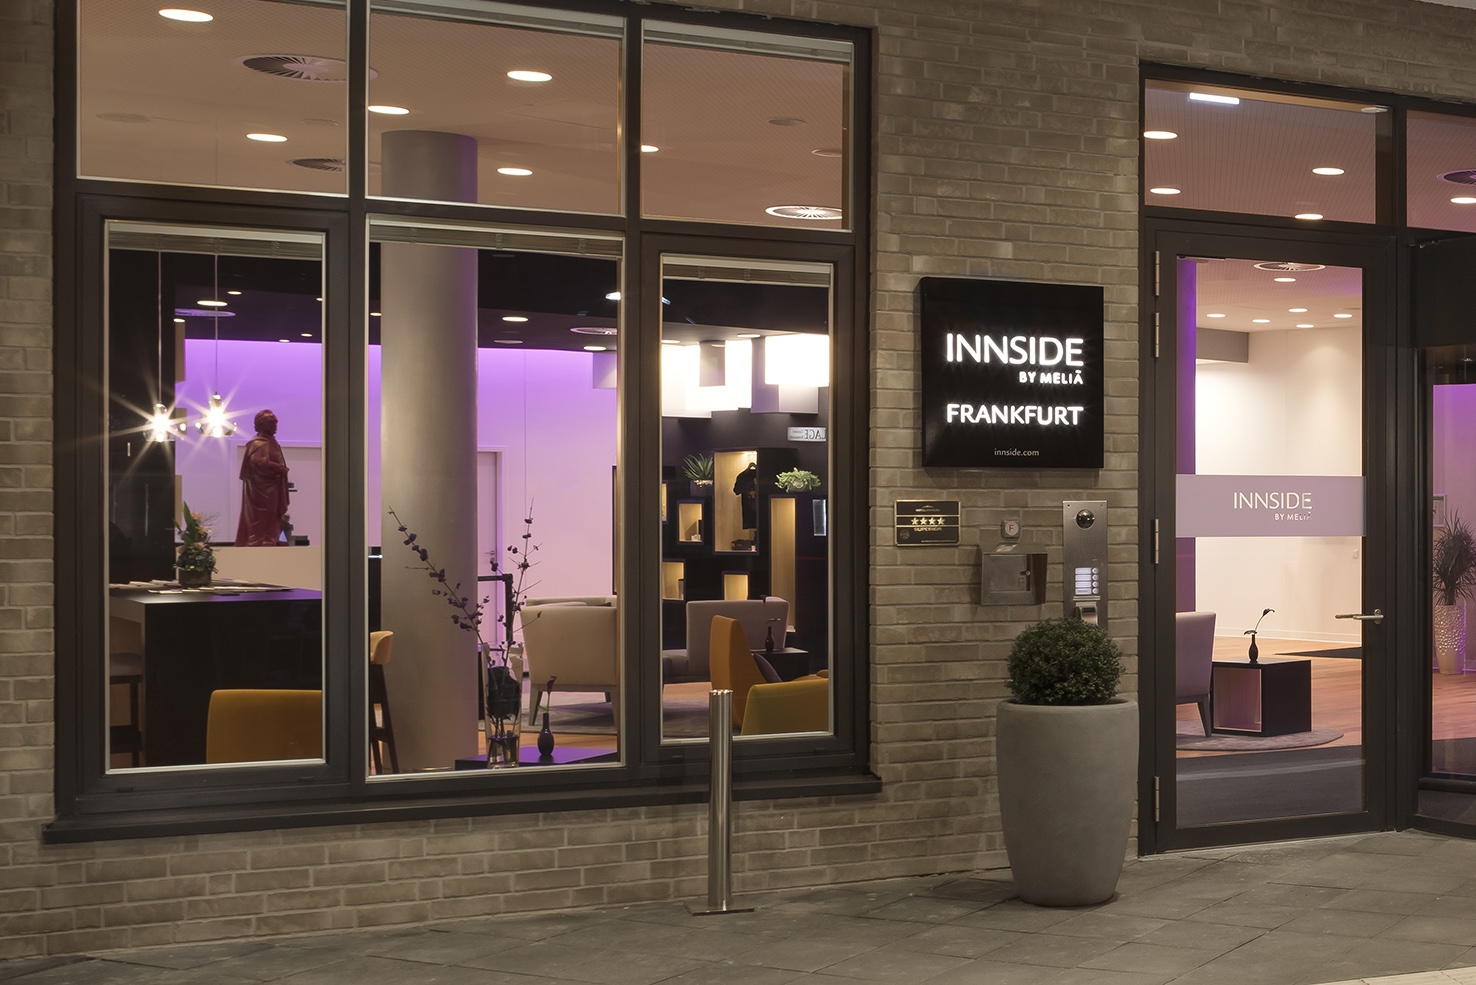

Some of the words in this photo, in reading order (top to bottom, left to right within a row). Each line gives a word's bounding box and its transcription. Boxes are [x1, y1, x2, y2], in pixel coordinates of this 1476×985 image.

[946, 333, 1085, 367] INNSIDE
[1019, 370, 1037, 383] BY
[946, 403, 1085, 426] FRANKFURT
[994, 447, 1040, 457] innside.com
[1233, 491, 1313, 510] INNSIDE
[1274, 513, 1285, 521] BY
[1008, 524, 1015, 533] F
[1017, 577, 1025, 588] F
